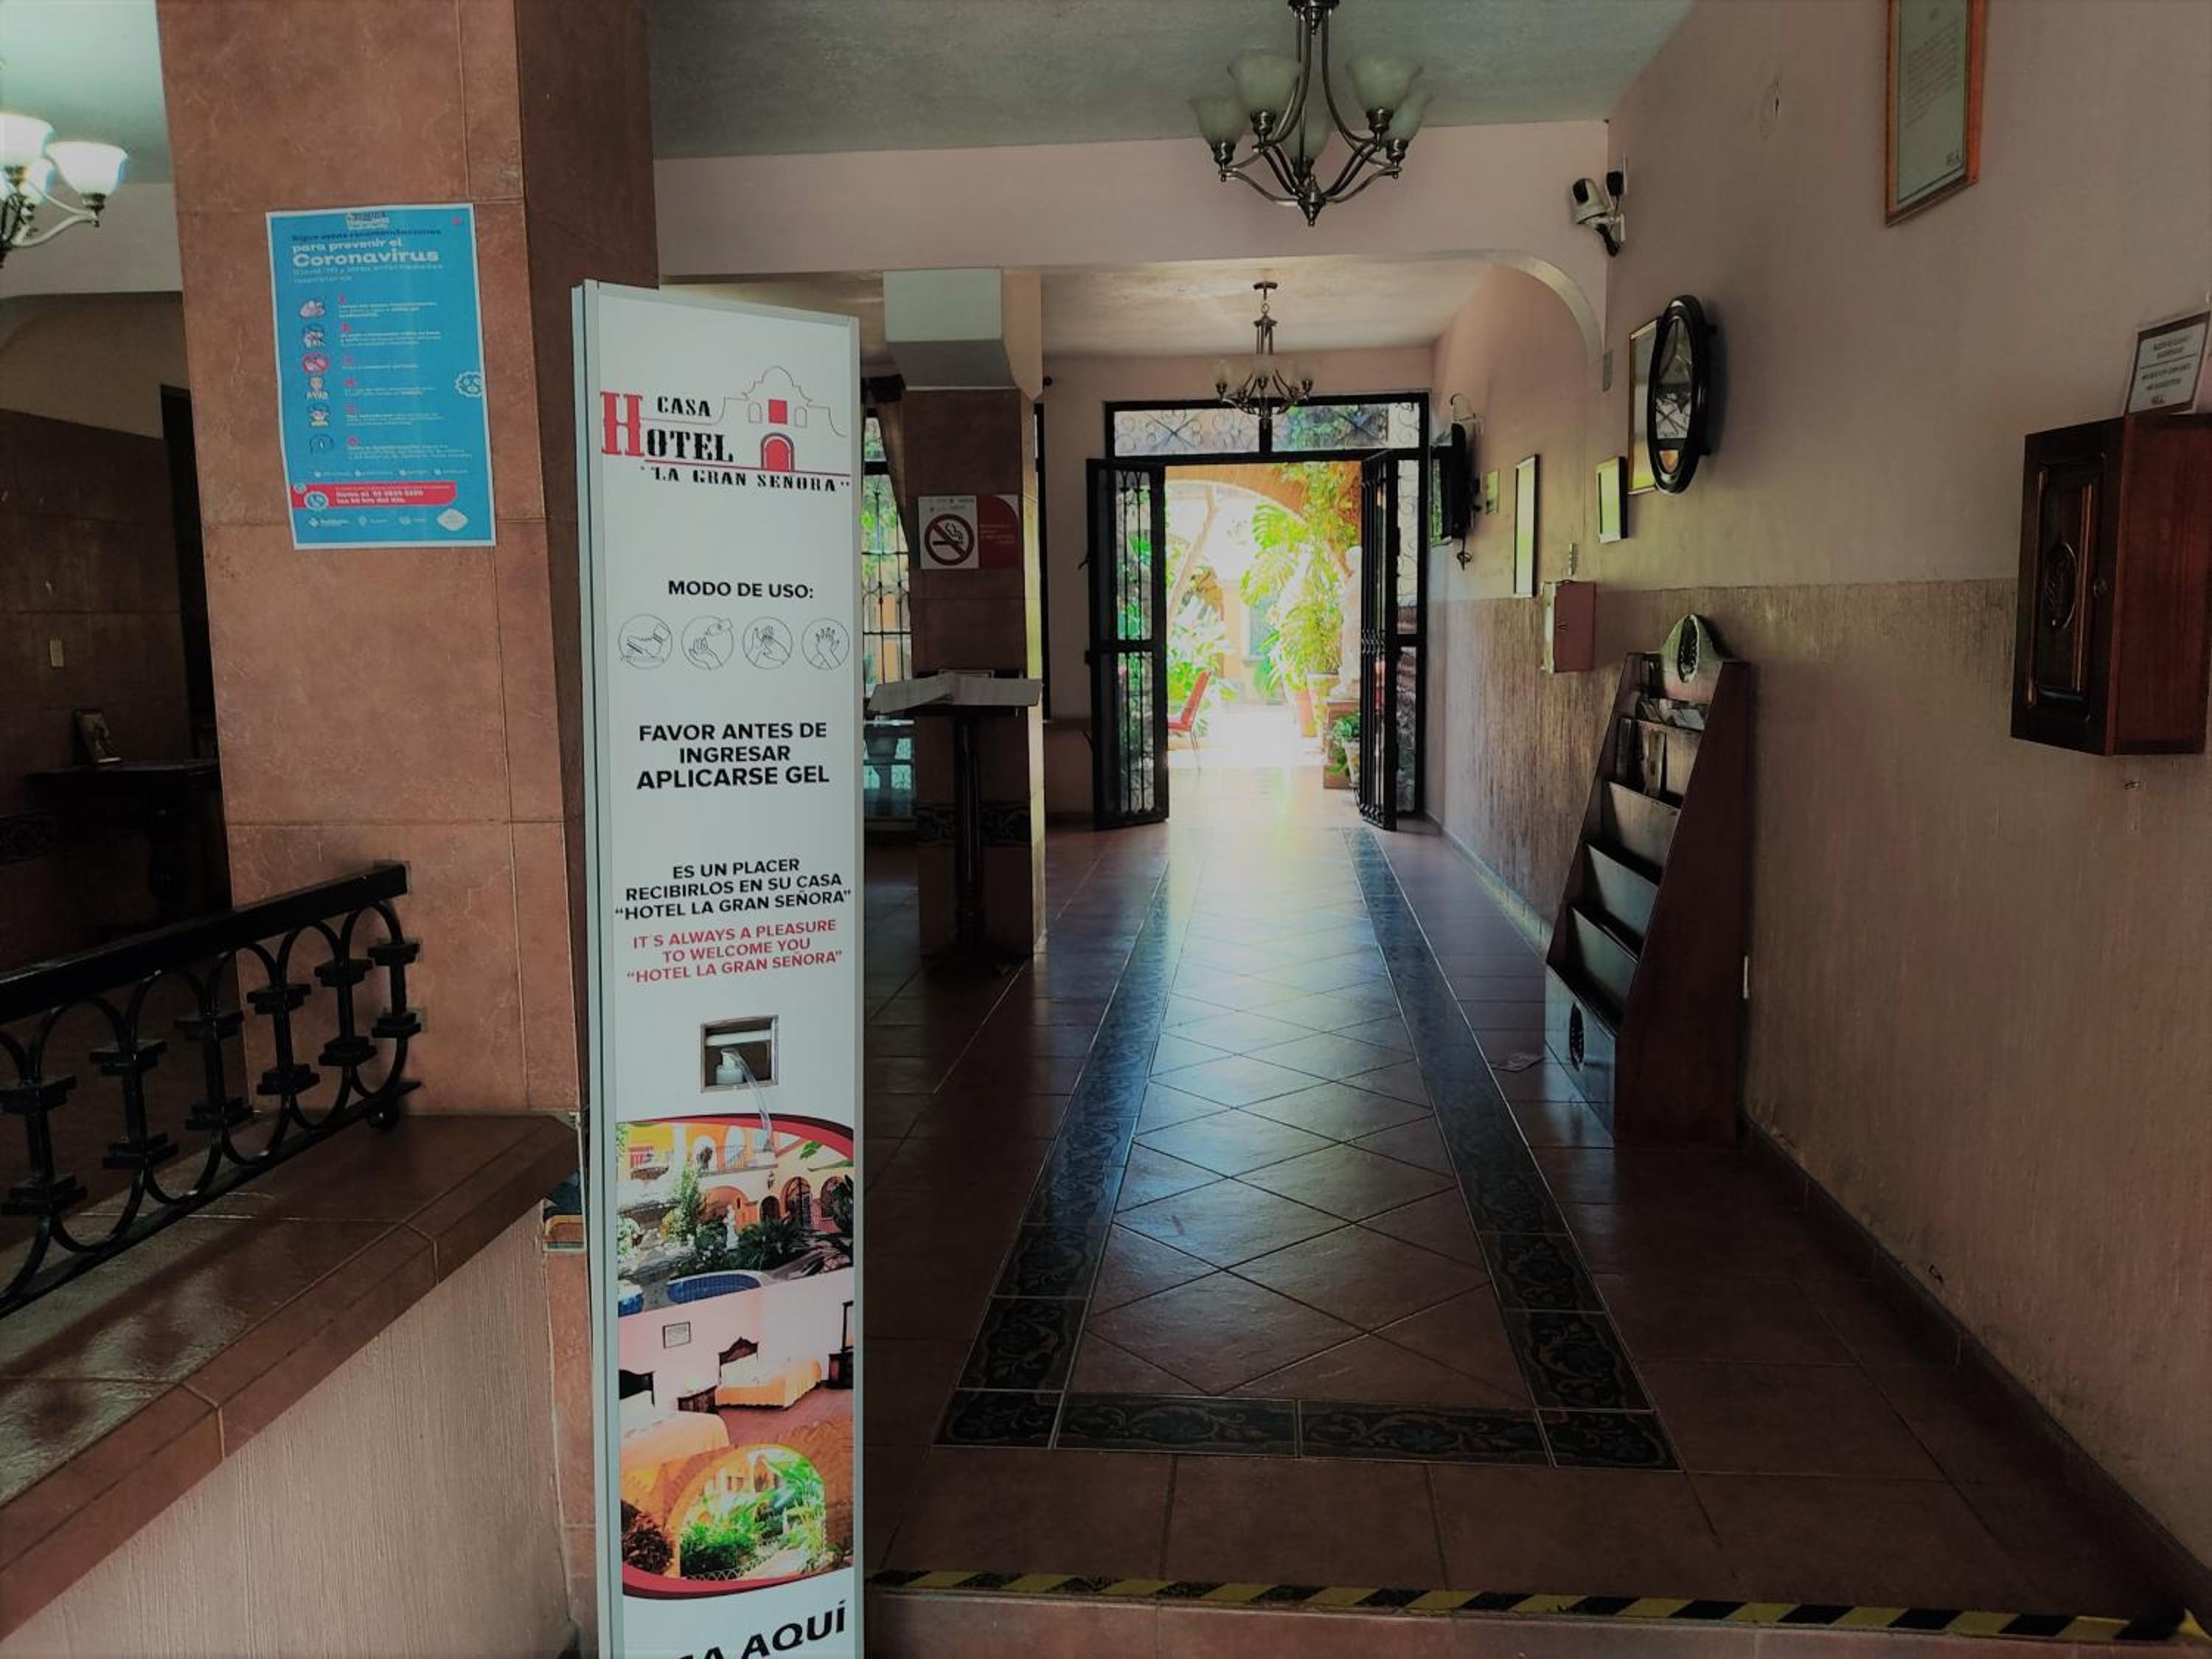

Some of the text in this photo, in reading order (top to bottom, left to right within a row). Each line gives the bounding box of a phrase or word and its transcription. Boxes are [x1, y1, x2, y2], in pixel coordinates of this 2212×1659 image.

[292, 237, 402, 254] para prevenir el
[293, 248, 439, 267] Coronavirus
[657, 395, 711, 417] CASA
[600, 391, 734, 462] HOTEL
[692, 470, 746, 486] GRAN
[668, 580, 813, 599] MODO DE USO:
[639, 723, 827, 741] FAVOR ANTES DE
[680, 745, 790, 763] INGRESAR
[636, 765, 830, 790] APLICARSE GEL
[673, 858, 800, 880] ES UN PLACER
[626, 874, 842, 901] RECIBIRLOS EN SU CASA
[692, 901, 714, 915] LA
[719, 896, 770, 913] GRAN
[669, 928, 735, 945] ALWAYS
[740, 927, 752, 939] A
[756, 919, 836, 938] PLEASURE
[663, 937, 811, 964] TO WELCOME YOU
[697, 964, 717, 978] LA
[722, 958, 768, 975] GRAN
[741, 1599, 846, 1659] AQUÍ
